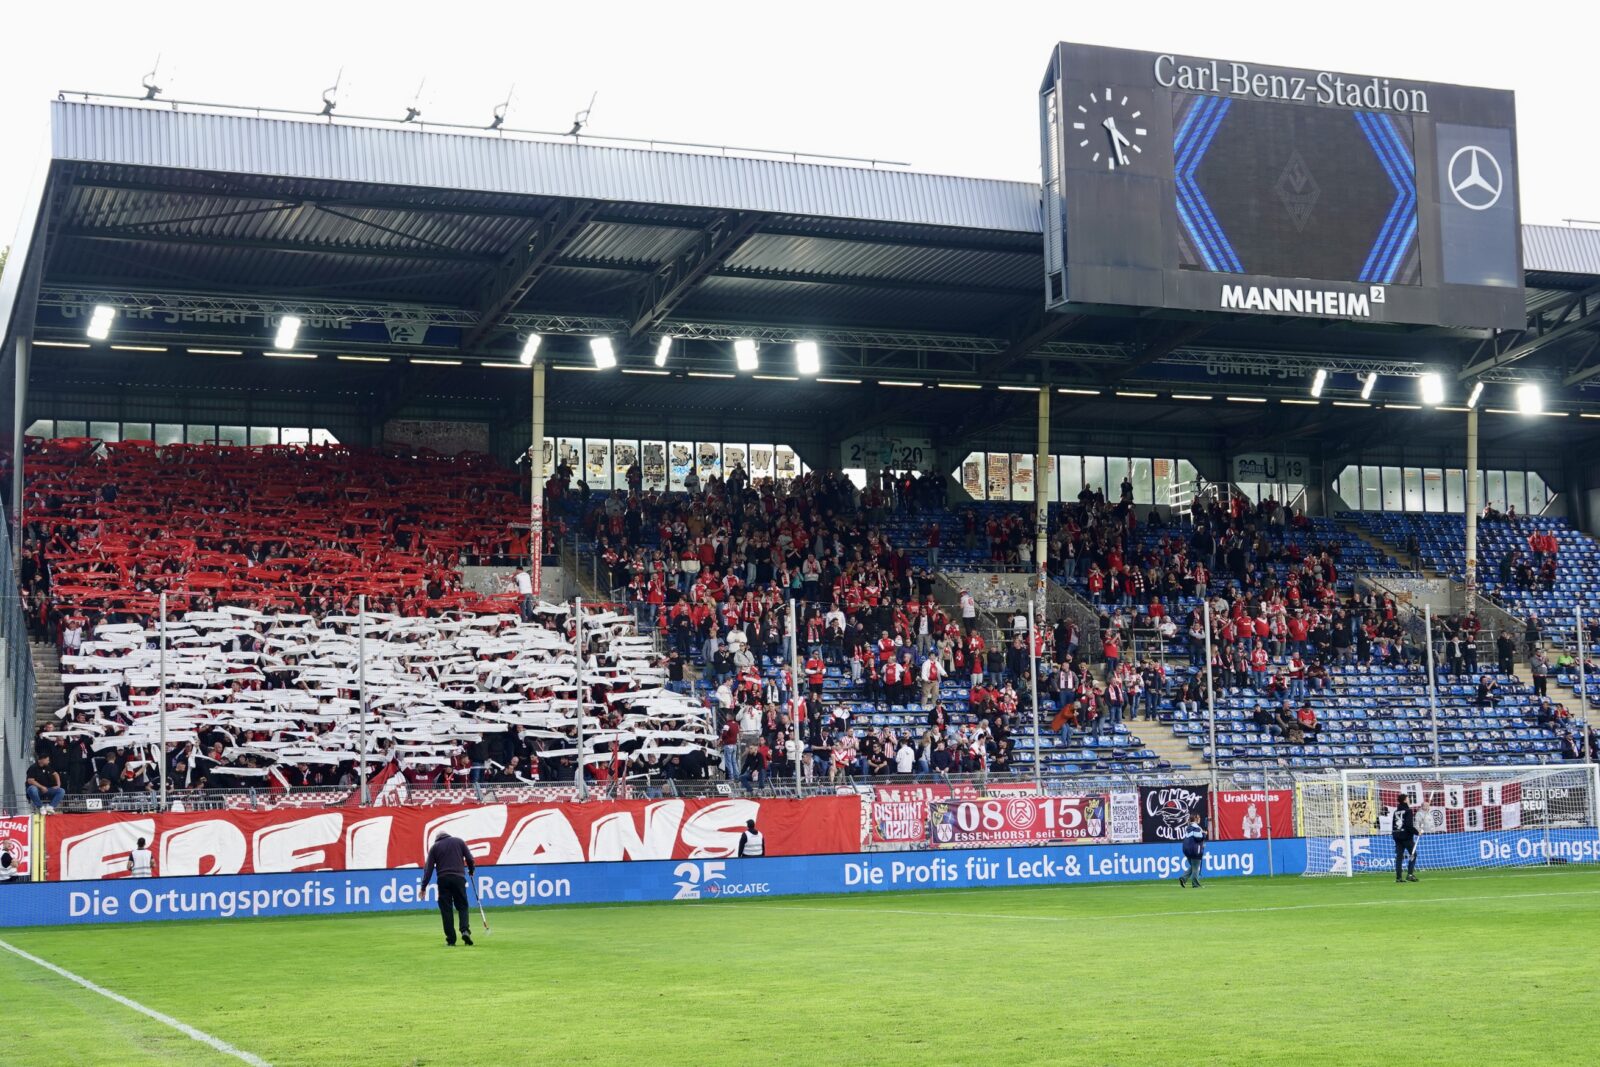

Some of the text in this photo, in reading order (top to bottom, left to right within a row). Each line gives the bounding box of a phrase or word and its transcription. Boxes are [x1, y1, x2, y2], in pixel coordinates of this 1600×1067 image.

[1154, 54, 1430, 113] Carl-Benz-Stadion
[61, 292, 154, 320] GÜTER
[1221, 285, 1370, 317] MANNHEIM
[88, 800, 101, 809] 27
[1223, 793, 1280, 802] Uralt-Ultas
[957, 801, 1005, 831] 08
[1039, 799, 1082, 829] 15
[60, 799, 761, 880] EDELFANS
[954, 829, 1087, 841] ESSEN-HORST seit 1996
[1156, 826, 1187, 840] CULTU
[1480, 838, 1511, 860] Die
[673, 861, 770, 899] 25 LOCATEC
[844, 861, 884, 885] Die
[891, 857, 958, 884] Profis
[965, 857, 999, 881] für
[1089, 852, 1254, 878] Leitungsotung
[69, 873, 571, 917] Die Ortungsprofis in dein Region
